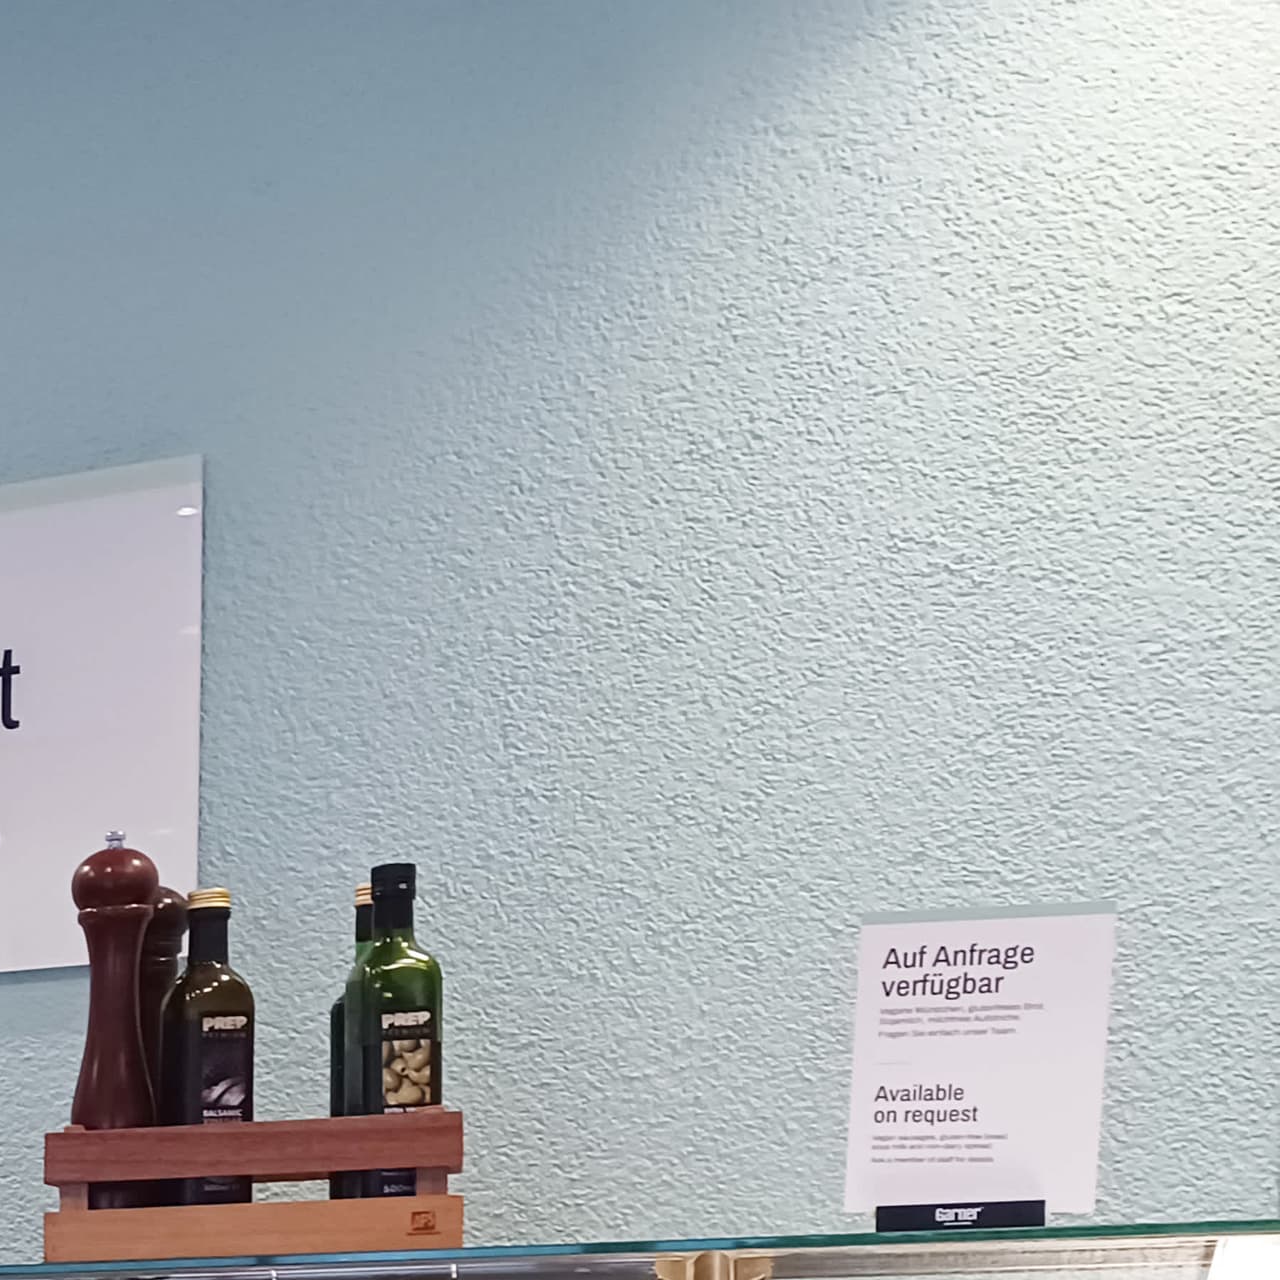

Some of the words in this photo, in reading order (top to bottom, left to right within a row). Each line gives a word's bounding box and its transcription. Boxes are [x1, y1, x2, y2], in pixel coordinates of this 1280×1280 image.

[881, 944, 928, 969] Auf
[931, 942, 1035, 970] Anfrage
[881, 971, 1005, 1001] verfügbar
[873, 1083, 965, 1102] Available
[873, 1109, 898, 1124] on
[903, 1106, 979, 1126] request
